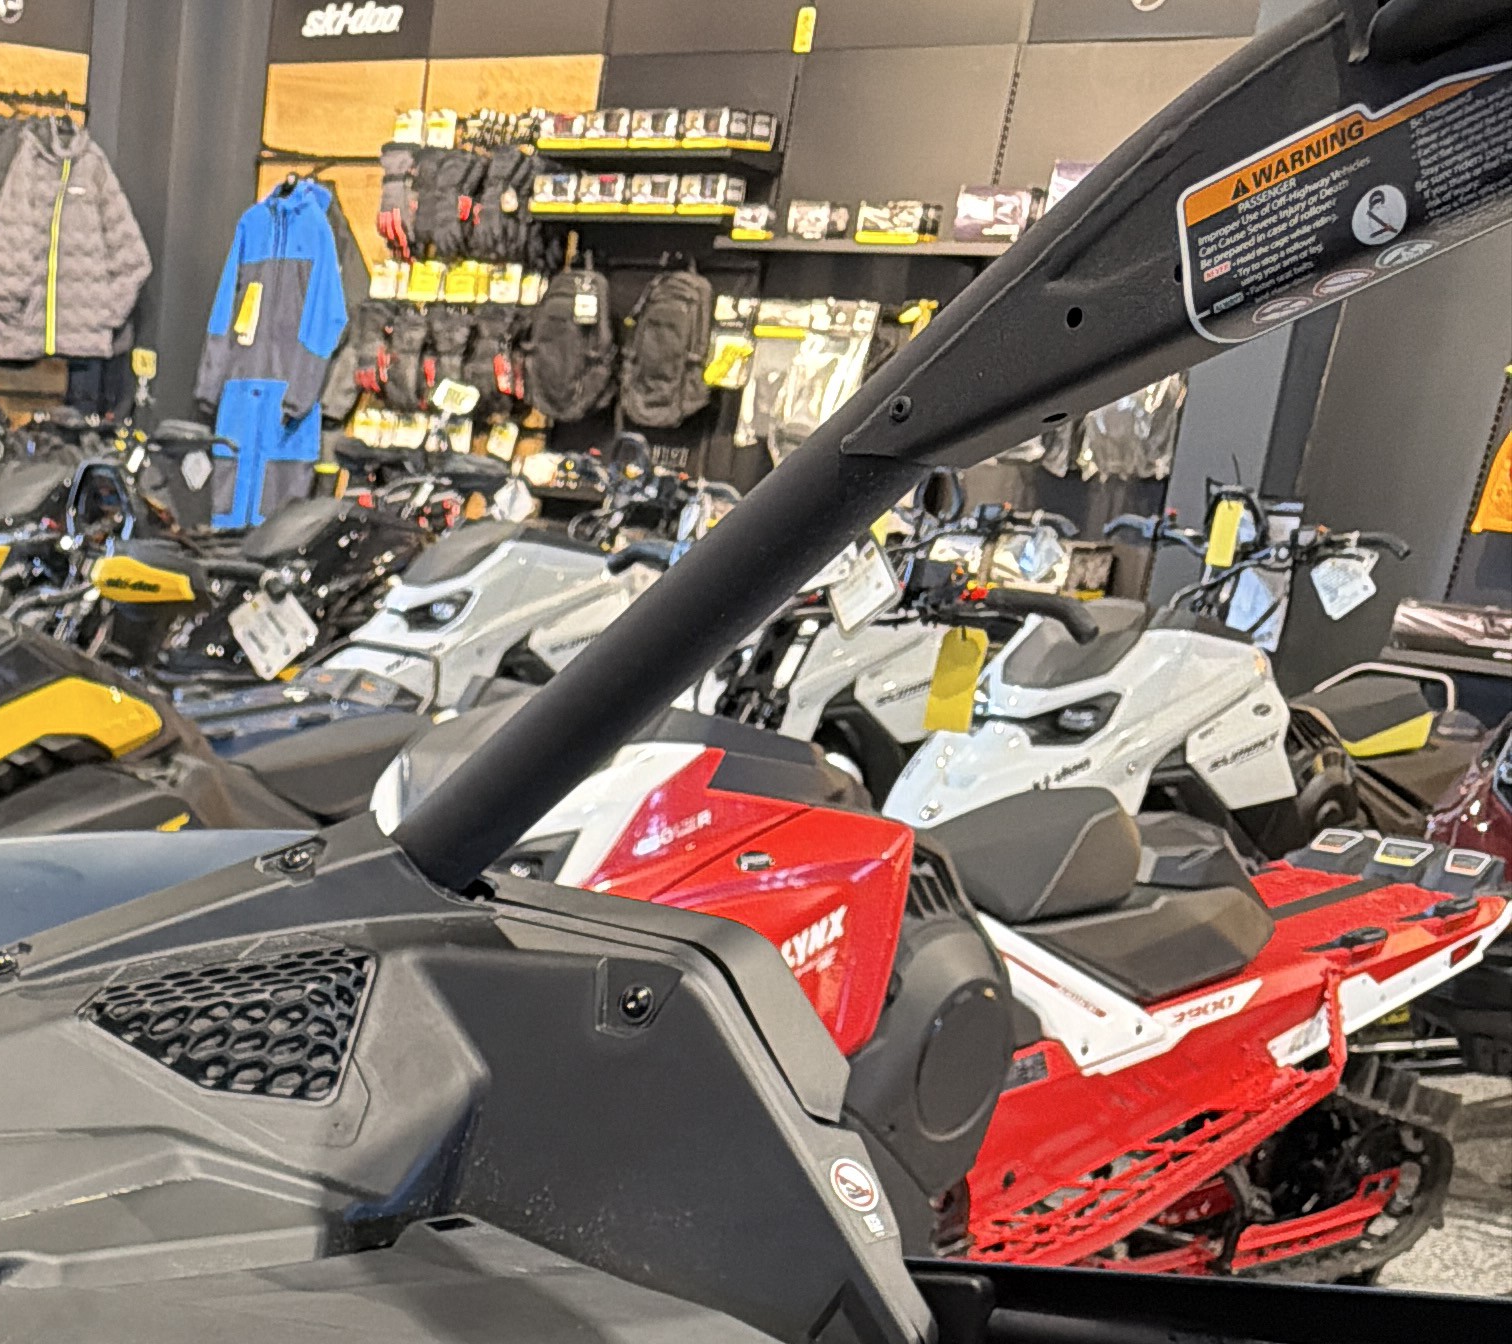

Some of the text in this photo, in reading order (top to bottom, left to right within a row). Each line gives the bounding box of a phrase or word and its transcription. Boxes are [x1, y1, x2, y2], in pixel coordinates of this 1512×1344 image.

[301, 1, 404, 37] ski-doo
[1251, 119, 1365, 189] WARNING
[1199, 154, 1368, 248] Improper Use of Off-Highway Vehicles
[1199, 177, 1347, 258] Can Cause Severe Injury or Death
[1238, 176, 1294, 214] PASSENGER
[1200, 256, 1210, 270] Be
[1214, 235, 1254, 265] prepared
[1258, 231, 1264, 242] in
[1267, 221, 1286, 238] case
[1289, 215, 1296, 227] of
[781, 905, 849, 969] LYNX
